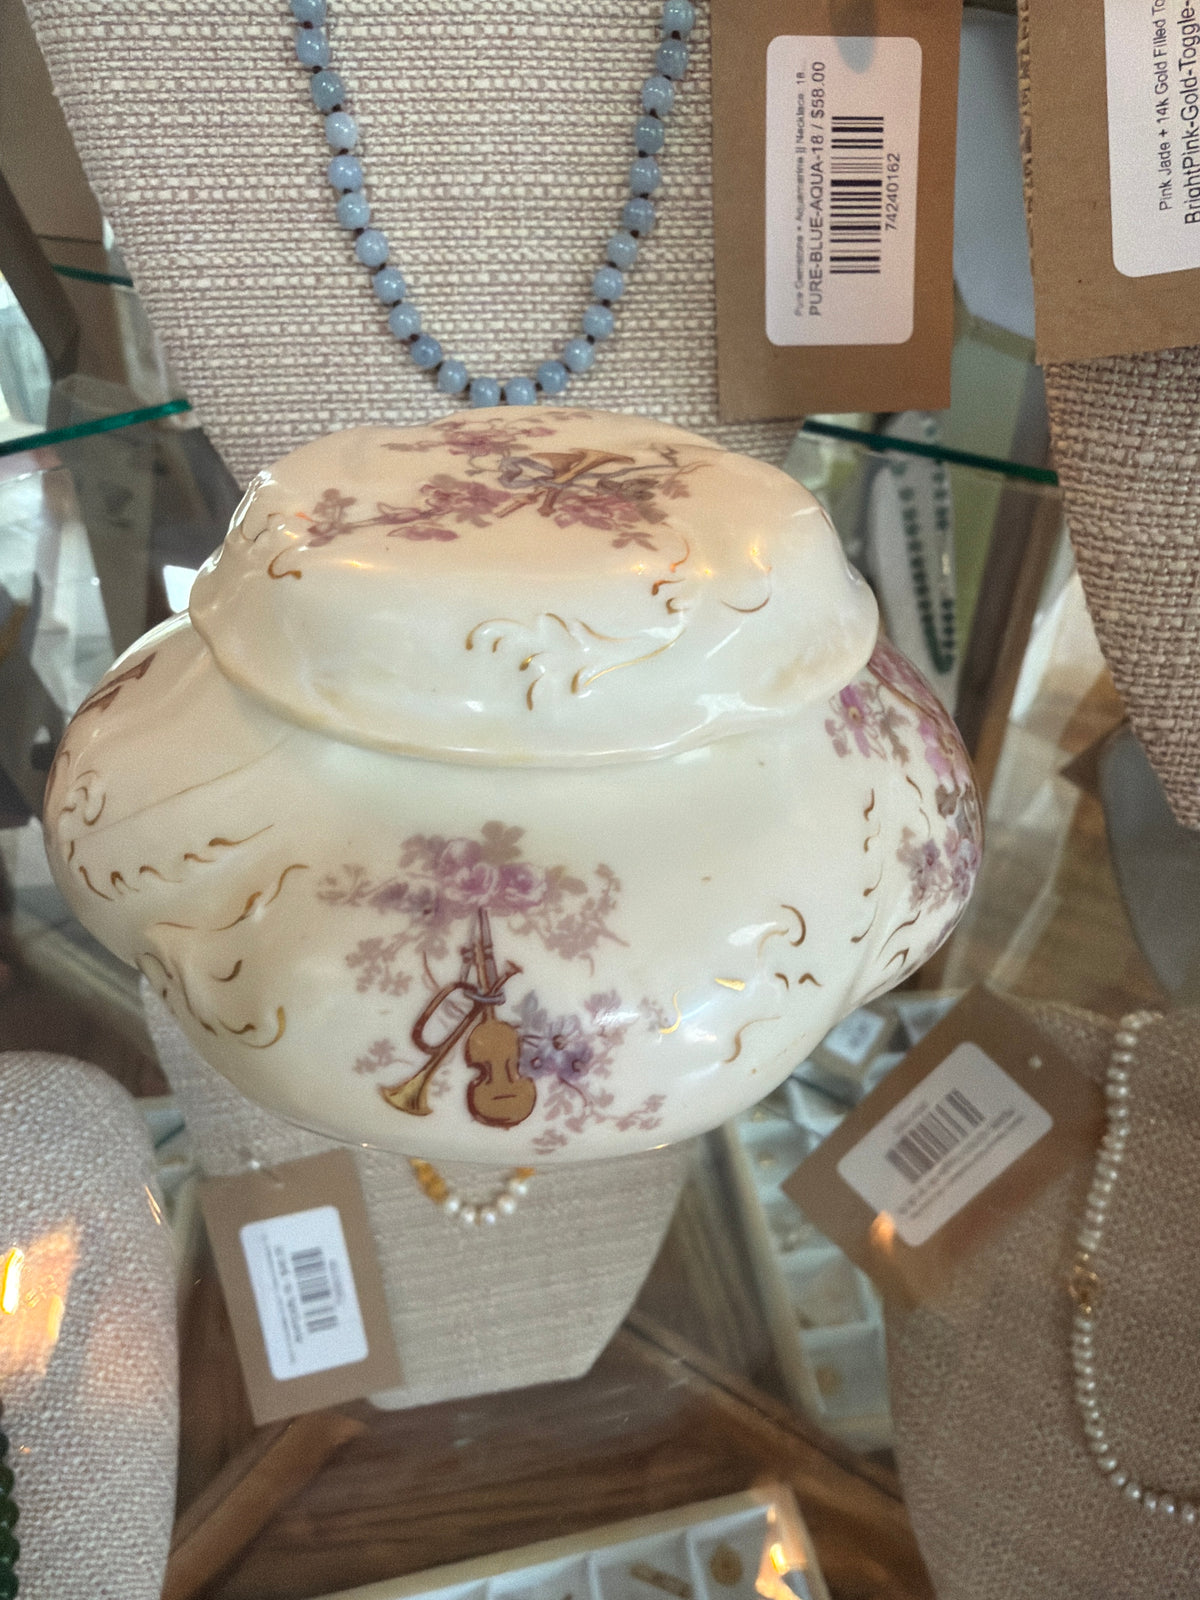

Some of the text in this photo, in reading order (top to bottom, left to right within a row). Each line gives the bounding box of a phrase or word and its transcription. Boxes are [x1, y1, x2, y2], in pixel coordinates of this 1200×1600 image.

[1152, 19, 1167, 58] Filled
[1154, 61, 1168, 95] Gold
[1156, 98, 1169, 124] 14k
[1158, 128, 1168, 138] +
[1158, 142, 1171, 176] Jade
[809, 61, 826, 317] PURE-BLUE-AQUA-18 / $58.00
[885, 153, 900, 231] 74240162
[1158, 180, 1172, 211] Pink
